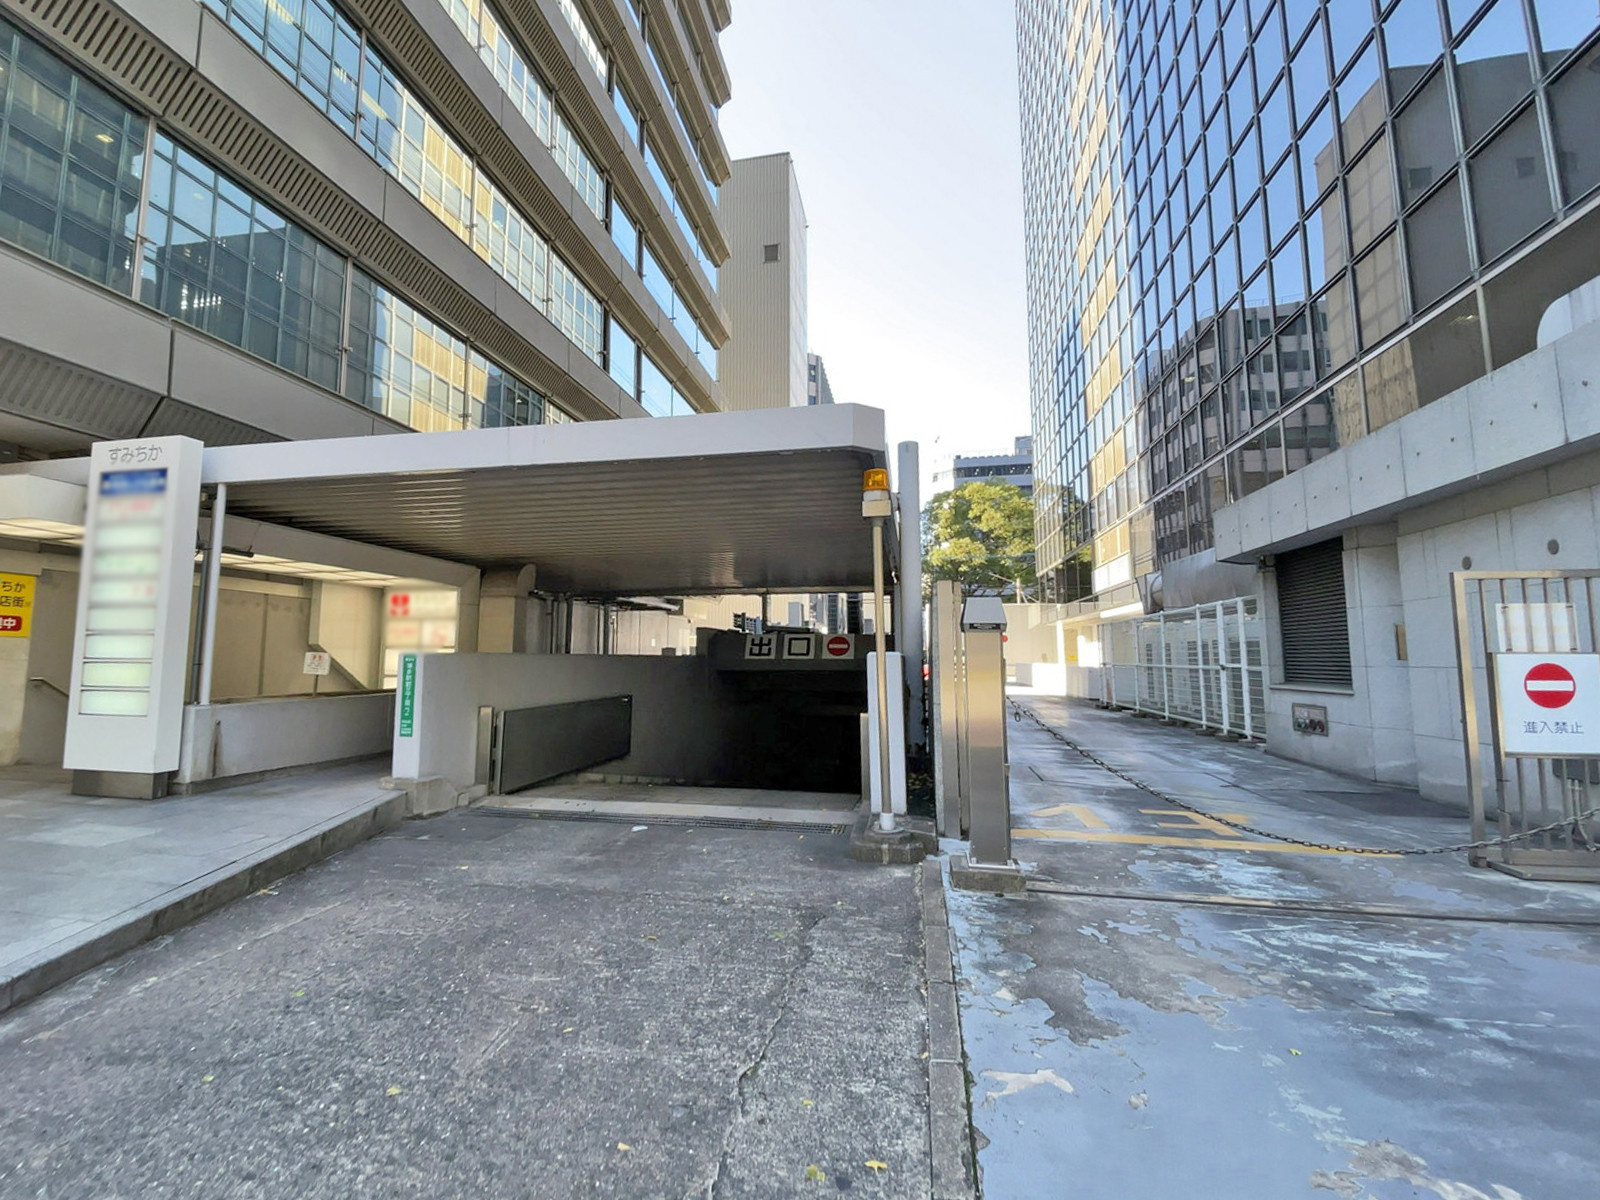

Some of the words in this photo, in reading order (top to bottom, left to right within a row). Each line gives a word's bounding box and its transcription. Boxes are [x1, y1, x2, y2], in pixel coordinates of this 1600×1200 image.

[108, 444, 163, 464] すみちか
[749, 635, 811, 657] 出口
[1523, 719, 1585, 735] 進入禁止
